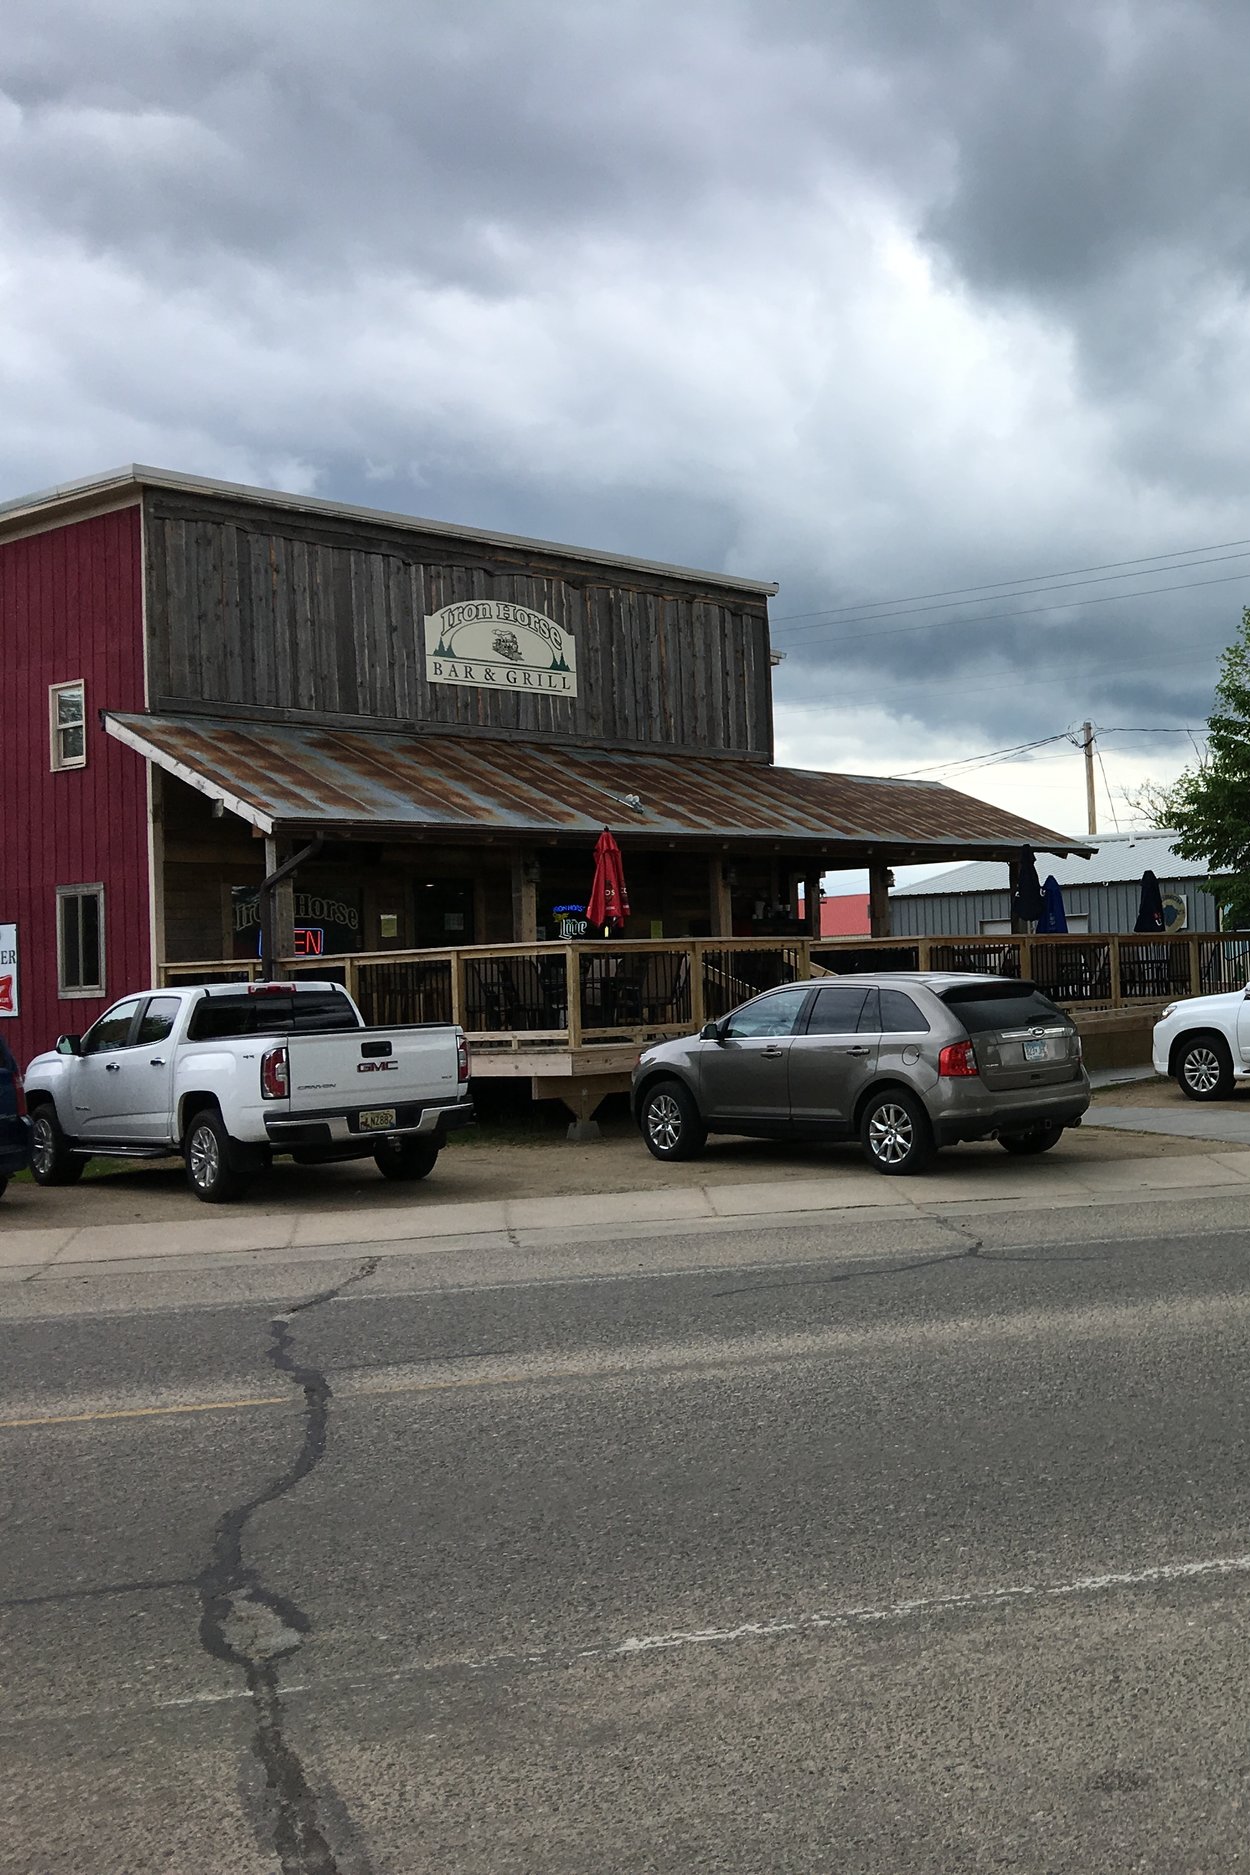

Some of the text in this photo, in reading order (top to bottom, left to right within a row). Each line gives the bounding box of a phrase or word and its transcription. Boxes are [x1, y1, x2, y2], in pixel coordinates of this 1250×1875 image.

[441, 603, 563, 650] Iron Horse
[433, 662, 571, 690] BAR & GRILL
[357, 1060, 399, 1073] GMC
